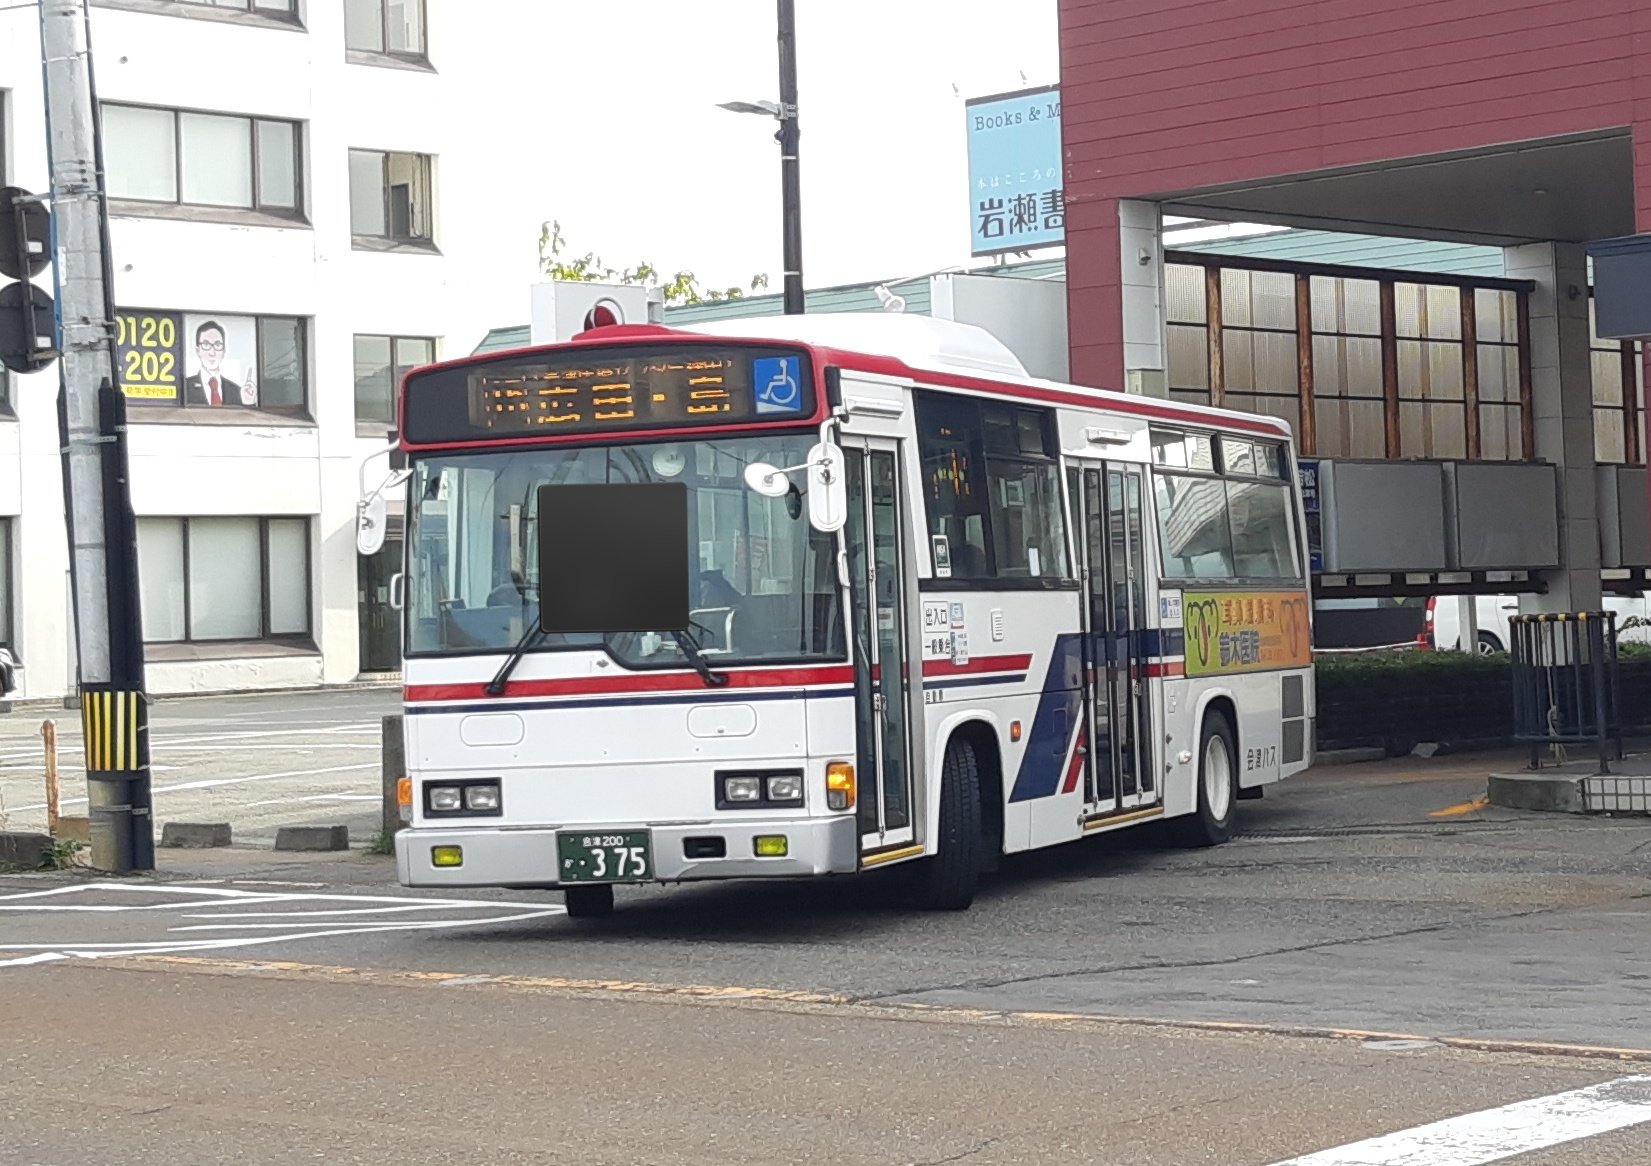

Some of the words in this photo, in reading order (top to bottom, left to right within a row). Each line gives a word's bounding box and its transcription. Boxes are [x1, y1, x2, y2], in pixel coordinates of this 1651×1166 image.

[975, 112, 1022, 131] Books
[1029, 106, 1040, 121] &
[978, 189, 1064, 238] 岩瀬書
[925, 608, 948, 626] 出入口
